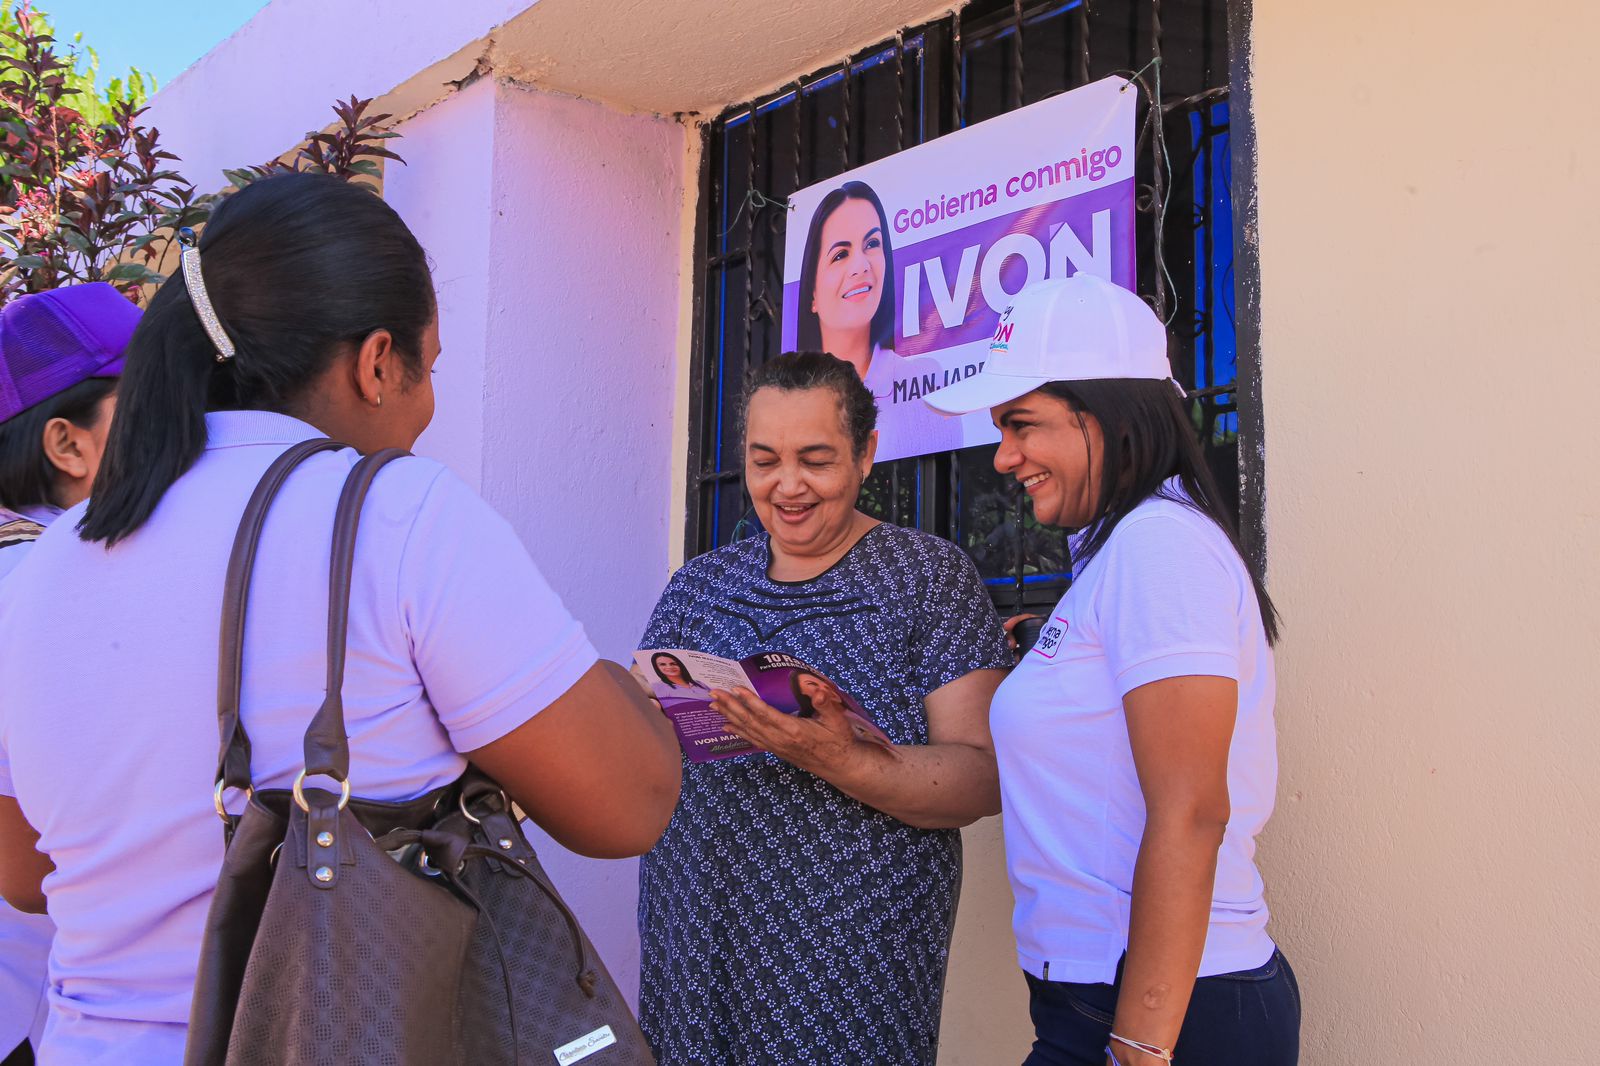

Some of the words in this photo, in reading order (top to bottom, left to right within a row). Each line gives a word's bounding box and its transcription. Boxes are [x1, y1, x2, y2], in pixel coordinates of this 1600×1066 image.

[893, 183, 998, 234] Gobierna
[1005, 144, 1123, 199] conmigo
[902, 208, 1112, 338] IVON
[763, 653, 782, 663] 10
[694, 736, 719, 746] IVON
